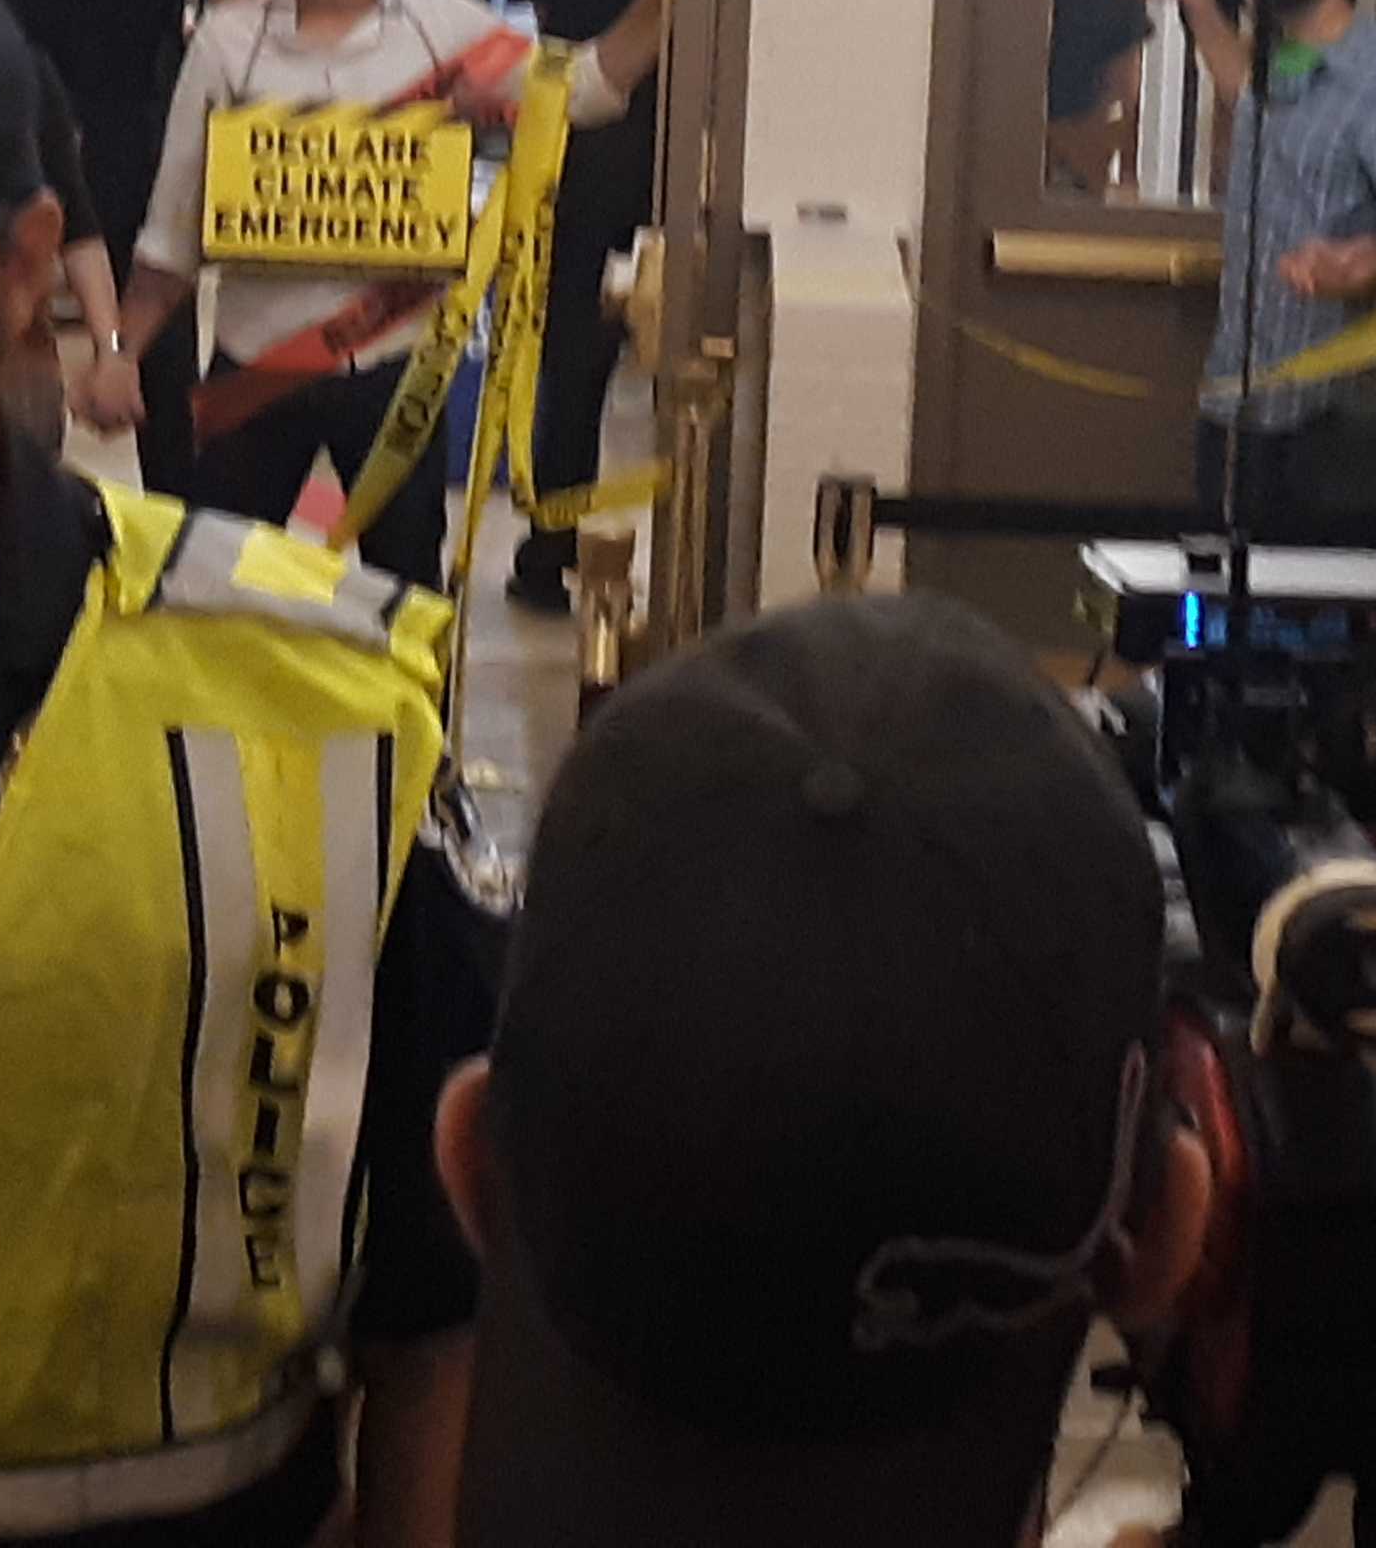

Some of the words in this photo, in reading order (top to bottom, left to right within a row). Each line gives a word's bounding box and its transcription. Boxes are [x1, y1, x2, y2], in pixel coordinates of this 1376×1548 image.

[249, 127, 427, 164] DECLARE
[254, 167, 422, 203] CLIMATE
[214, 209, 454, 249] EMERGENCY
[238, 906, 311, 1289] POLICE
